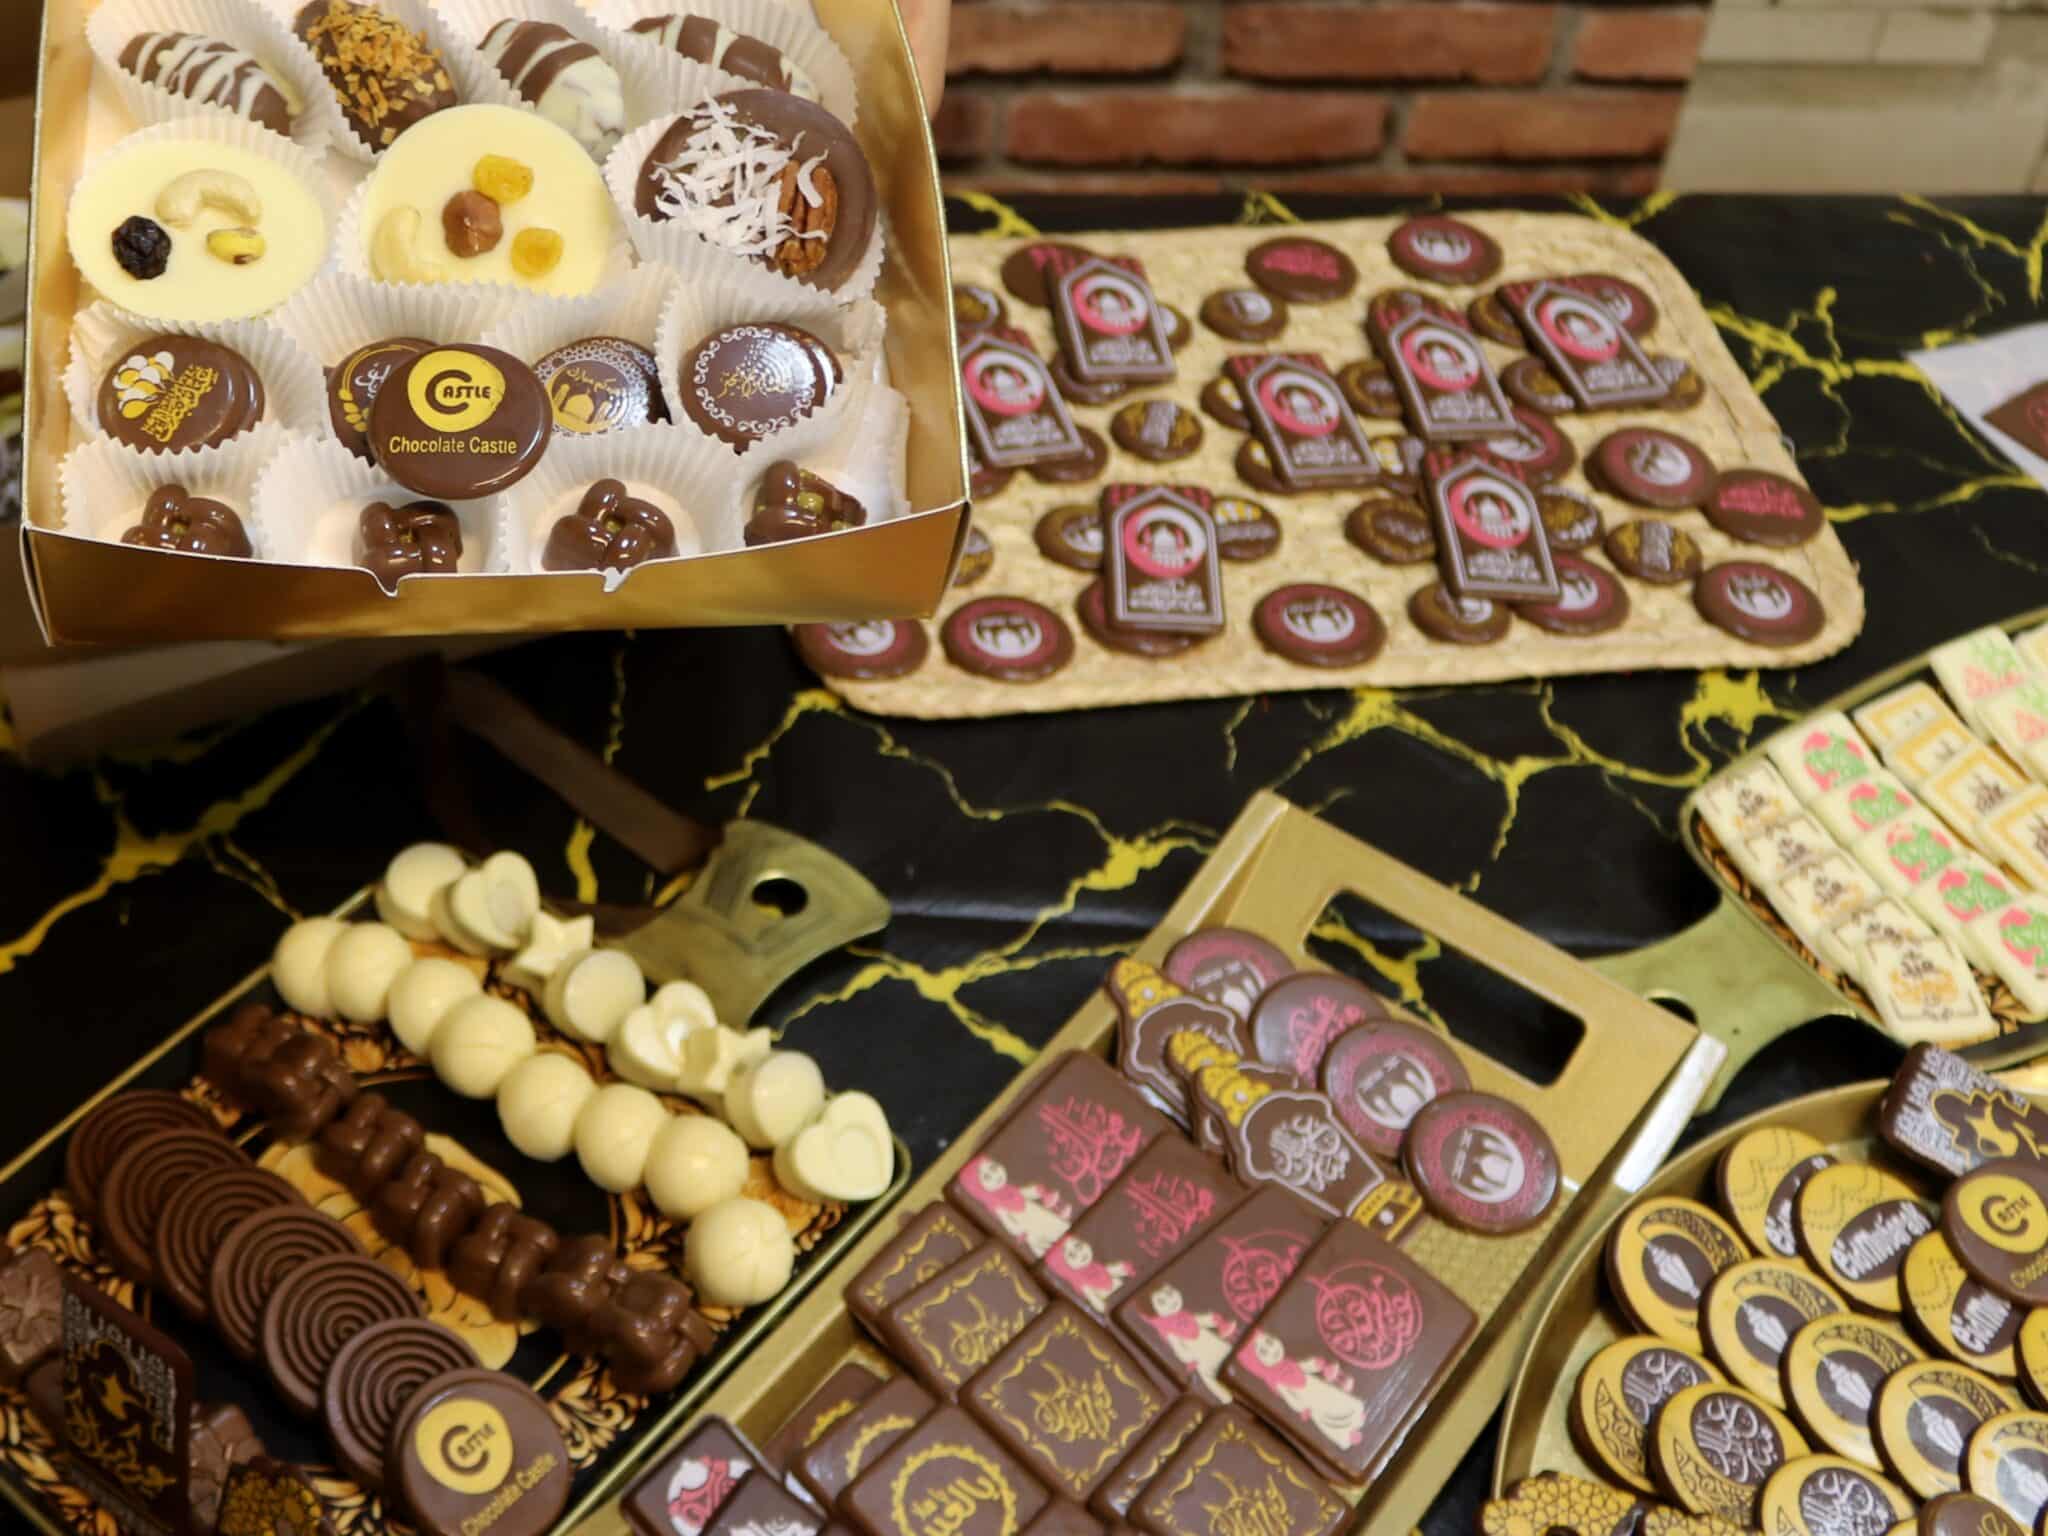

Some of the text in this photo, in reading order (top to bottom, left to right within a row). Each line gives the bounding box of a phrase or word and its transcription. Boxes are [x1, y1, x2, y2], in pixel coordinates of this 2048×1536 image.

[426, 369, 491, 415] CASTLE
[389, 436, 517, 454] Chocolate Castle
